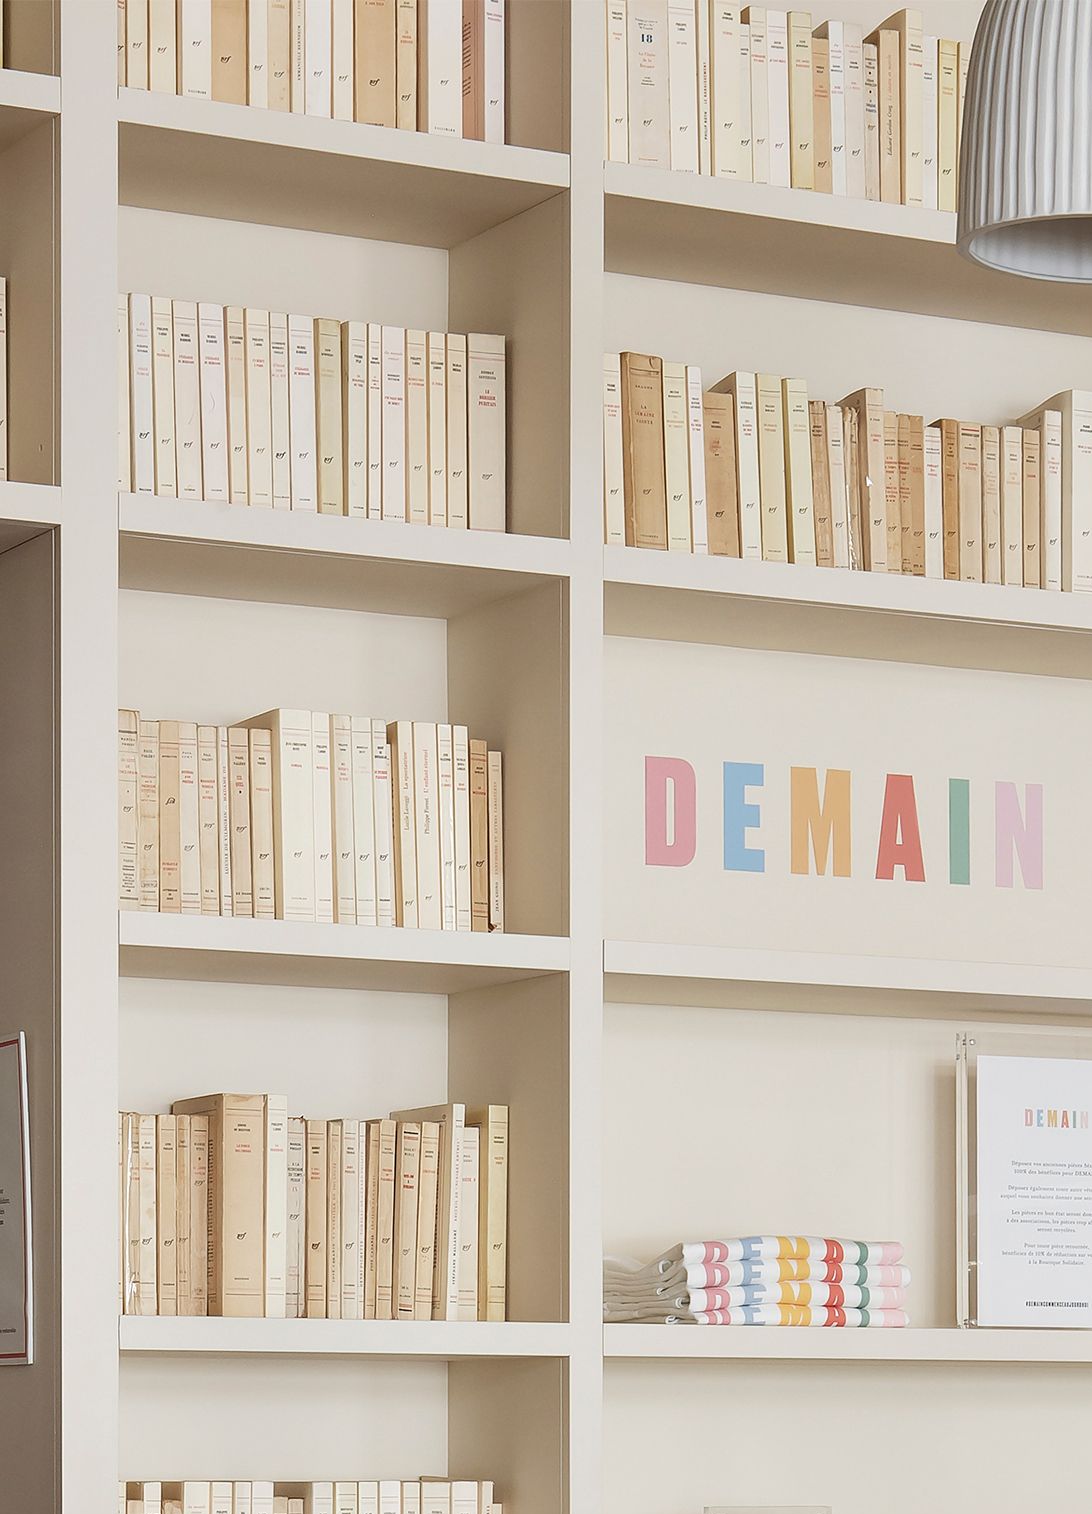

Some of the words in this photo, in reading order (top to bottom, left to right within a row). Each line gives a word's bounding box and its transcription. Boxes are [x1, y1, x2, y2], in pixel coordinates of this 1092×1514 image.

[641, 33, 653, 43] 18
[645, 755, 1044, 890] DEMAIN
[1025, 1107, 1089, 1129] DEMAIN
